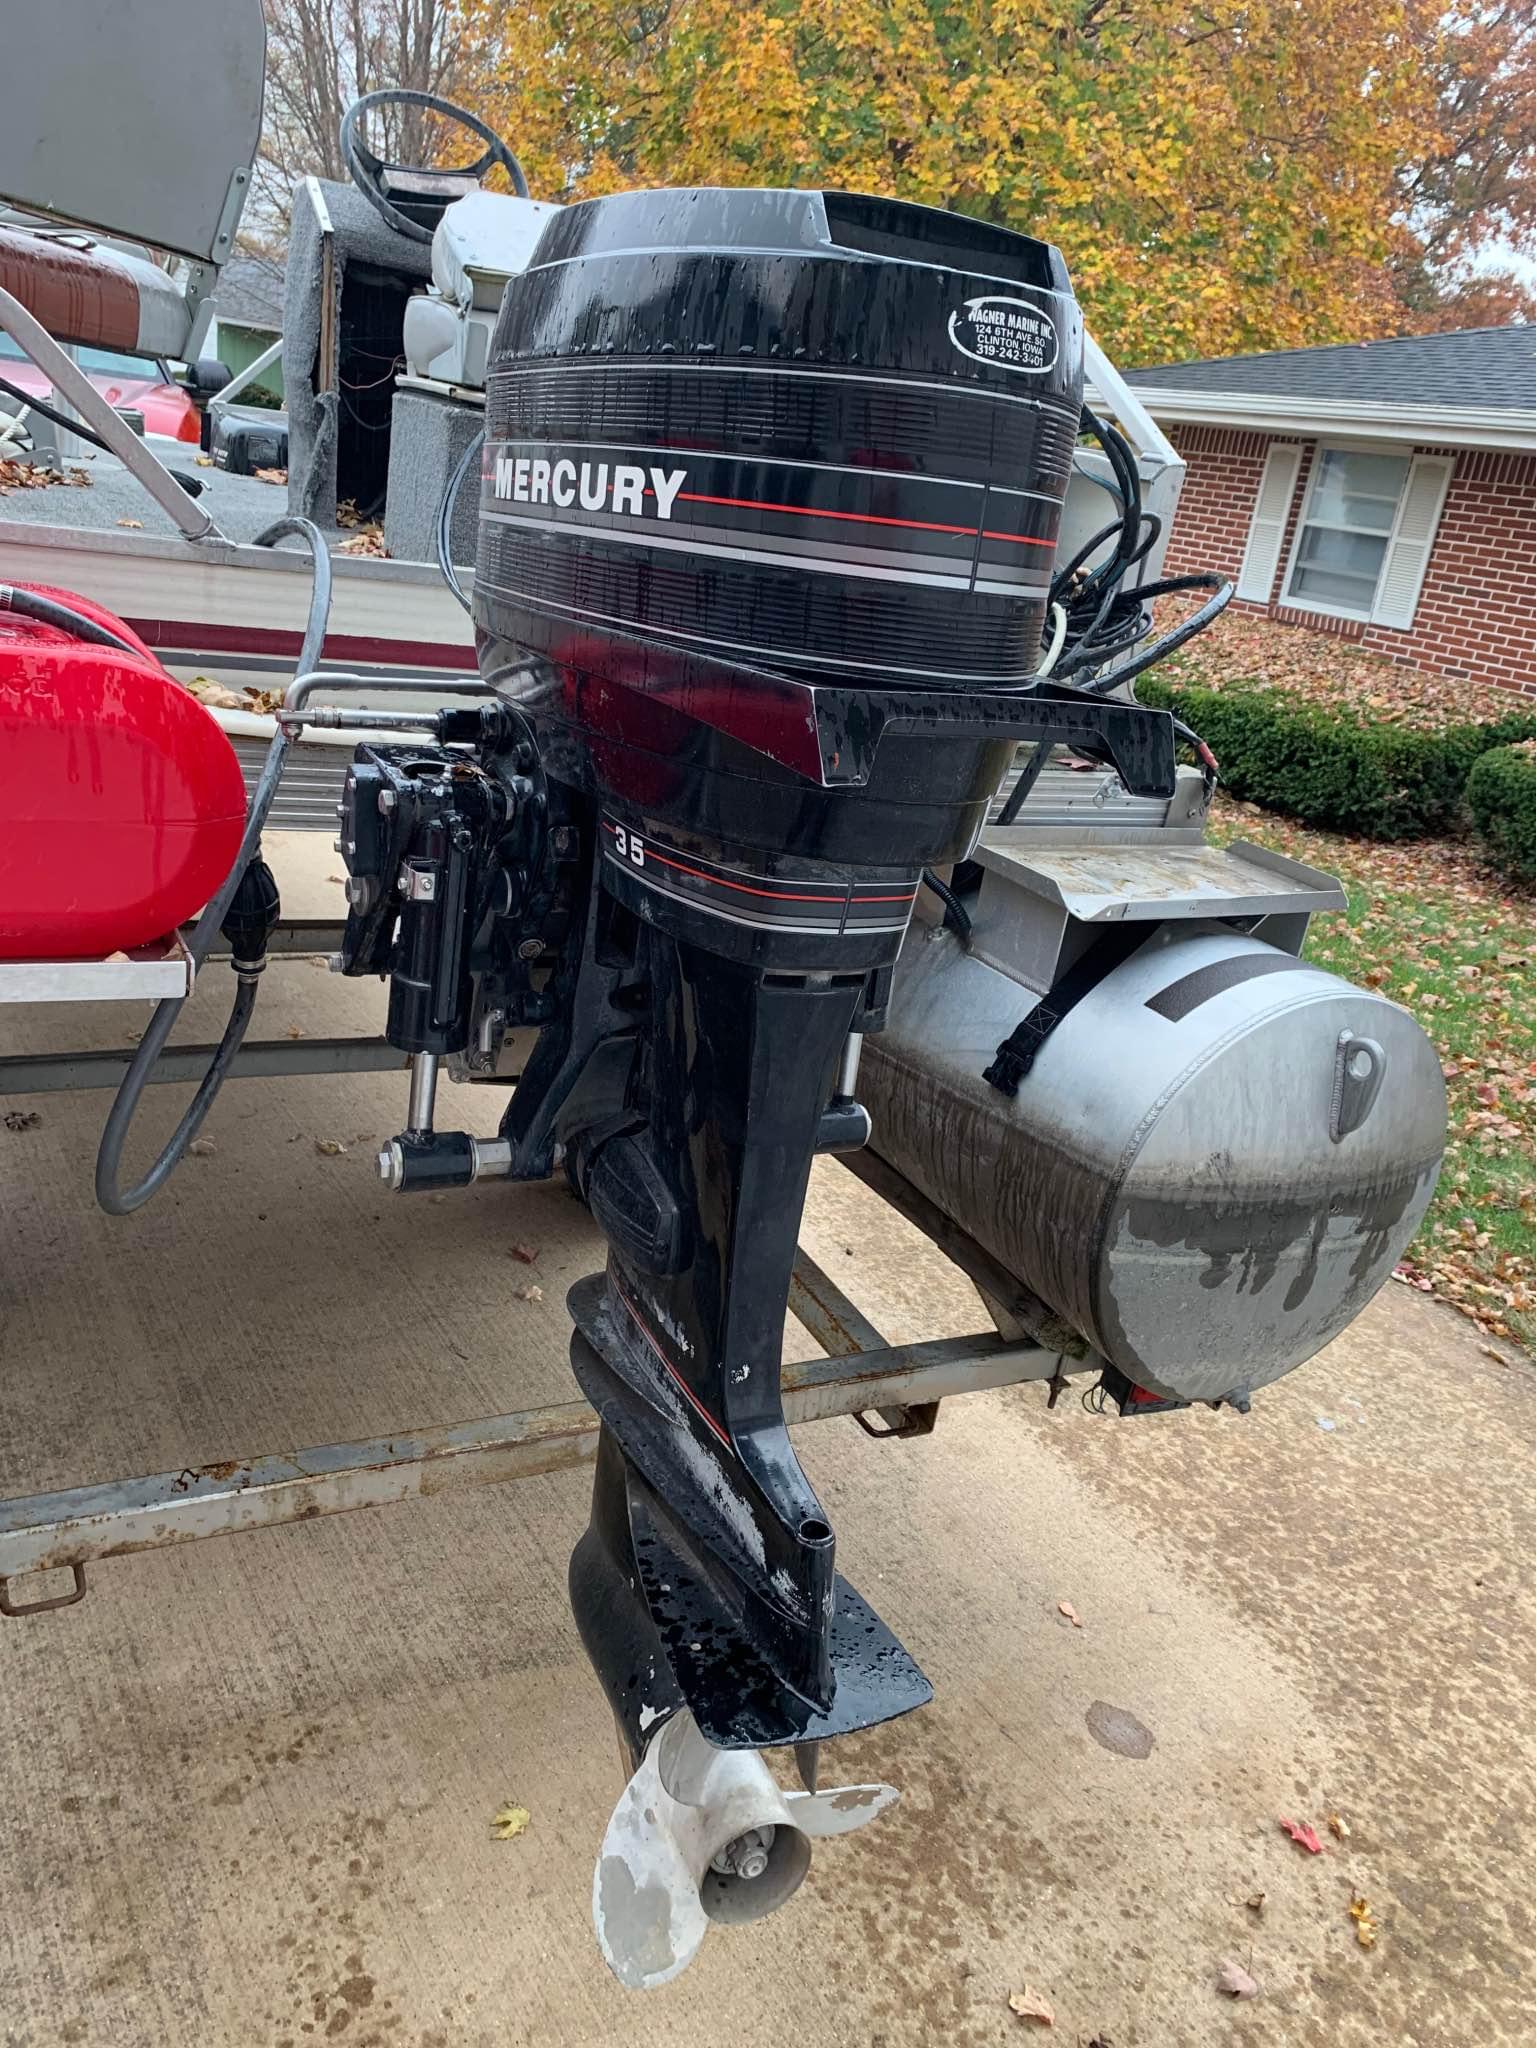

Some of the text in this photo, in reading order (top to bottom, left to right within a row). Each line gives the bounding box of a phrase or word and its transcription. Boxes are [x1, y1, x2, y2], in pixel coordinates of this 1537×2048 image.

[968, 308, 1006, 327] WAGNER
[1008, 314, 1039, 335] MARINE
[975, 324, 992, 335] 124
[994, 328, 1014, 338] 6TH
[1022, 343, 1043, 357] IOWA
[495, 458, 688, 519] MERCURY
[615, 825, 645, 867] 35
